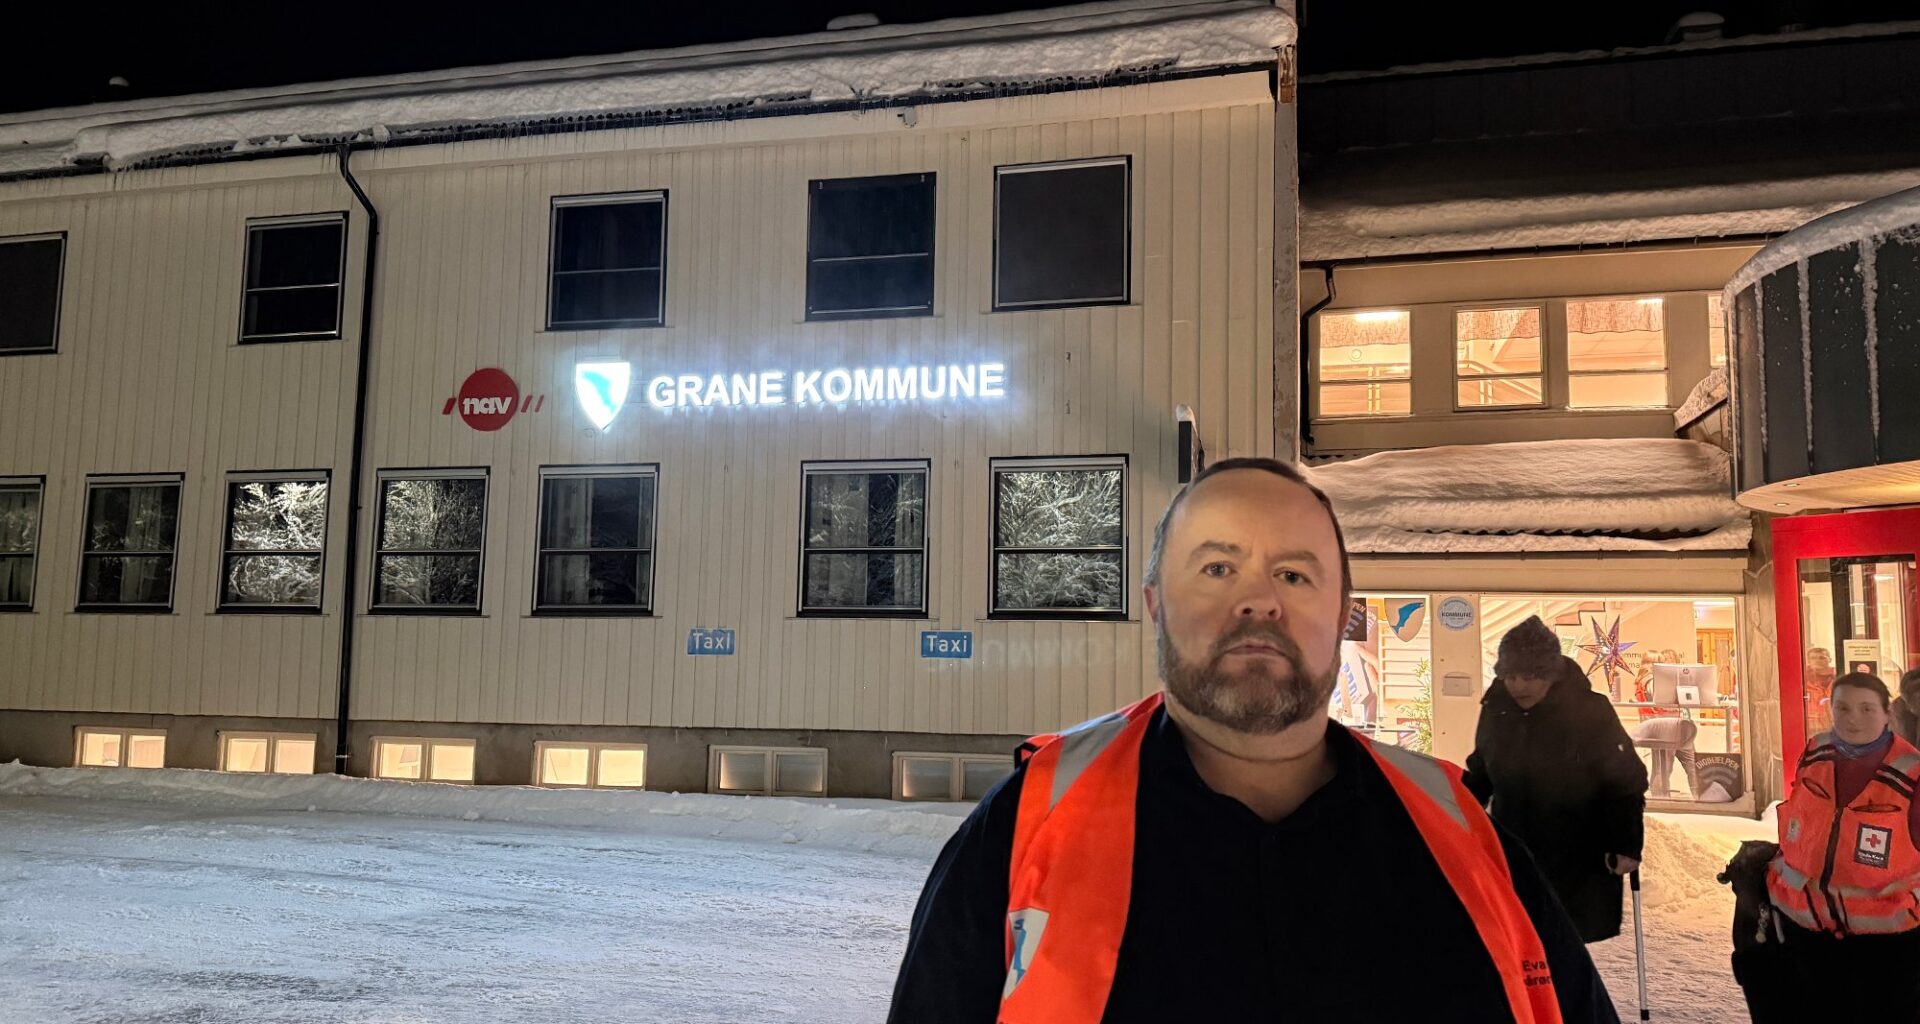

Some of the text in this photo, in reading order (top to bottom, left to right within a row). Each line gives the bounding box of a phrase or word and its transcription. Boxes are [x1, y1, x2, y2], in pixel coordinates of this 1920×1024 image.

[648, 364, 1005, 407] GRANE KOMMUNE
[463, 396, 513, 416] nav
[692, 632, 732, 650] Taxi
[926, 634, 968, 653] Taxi
